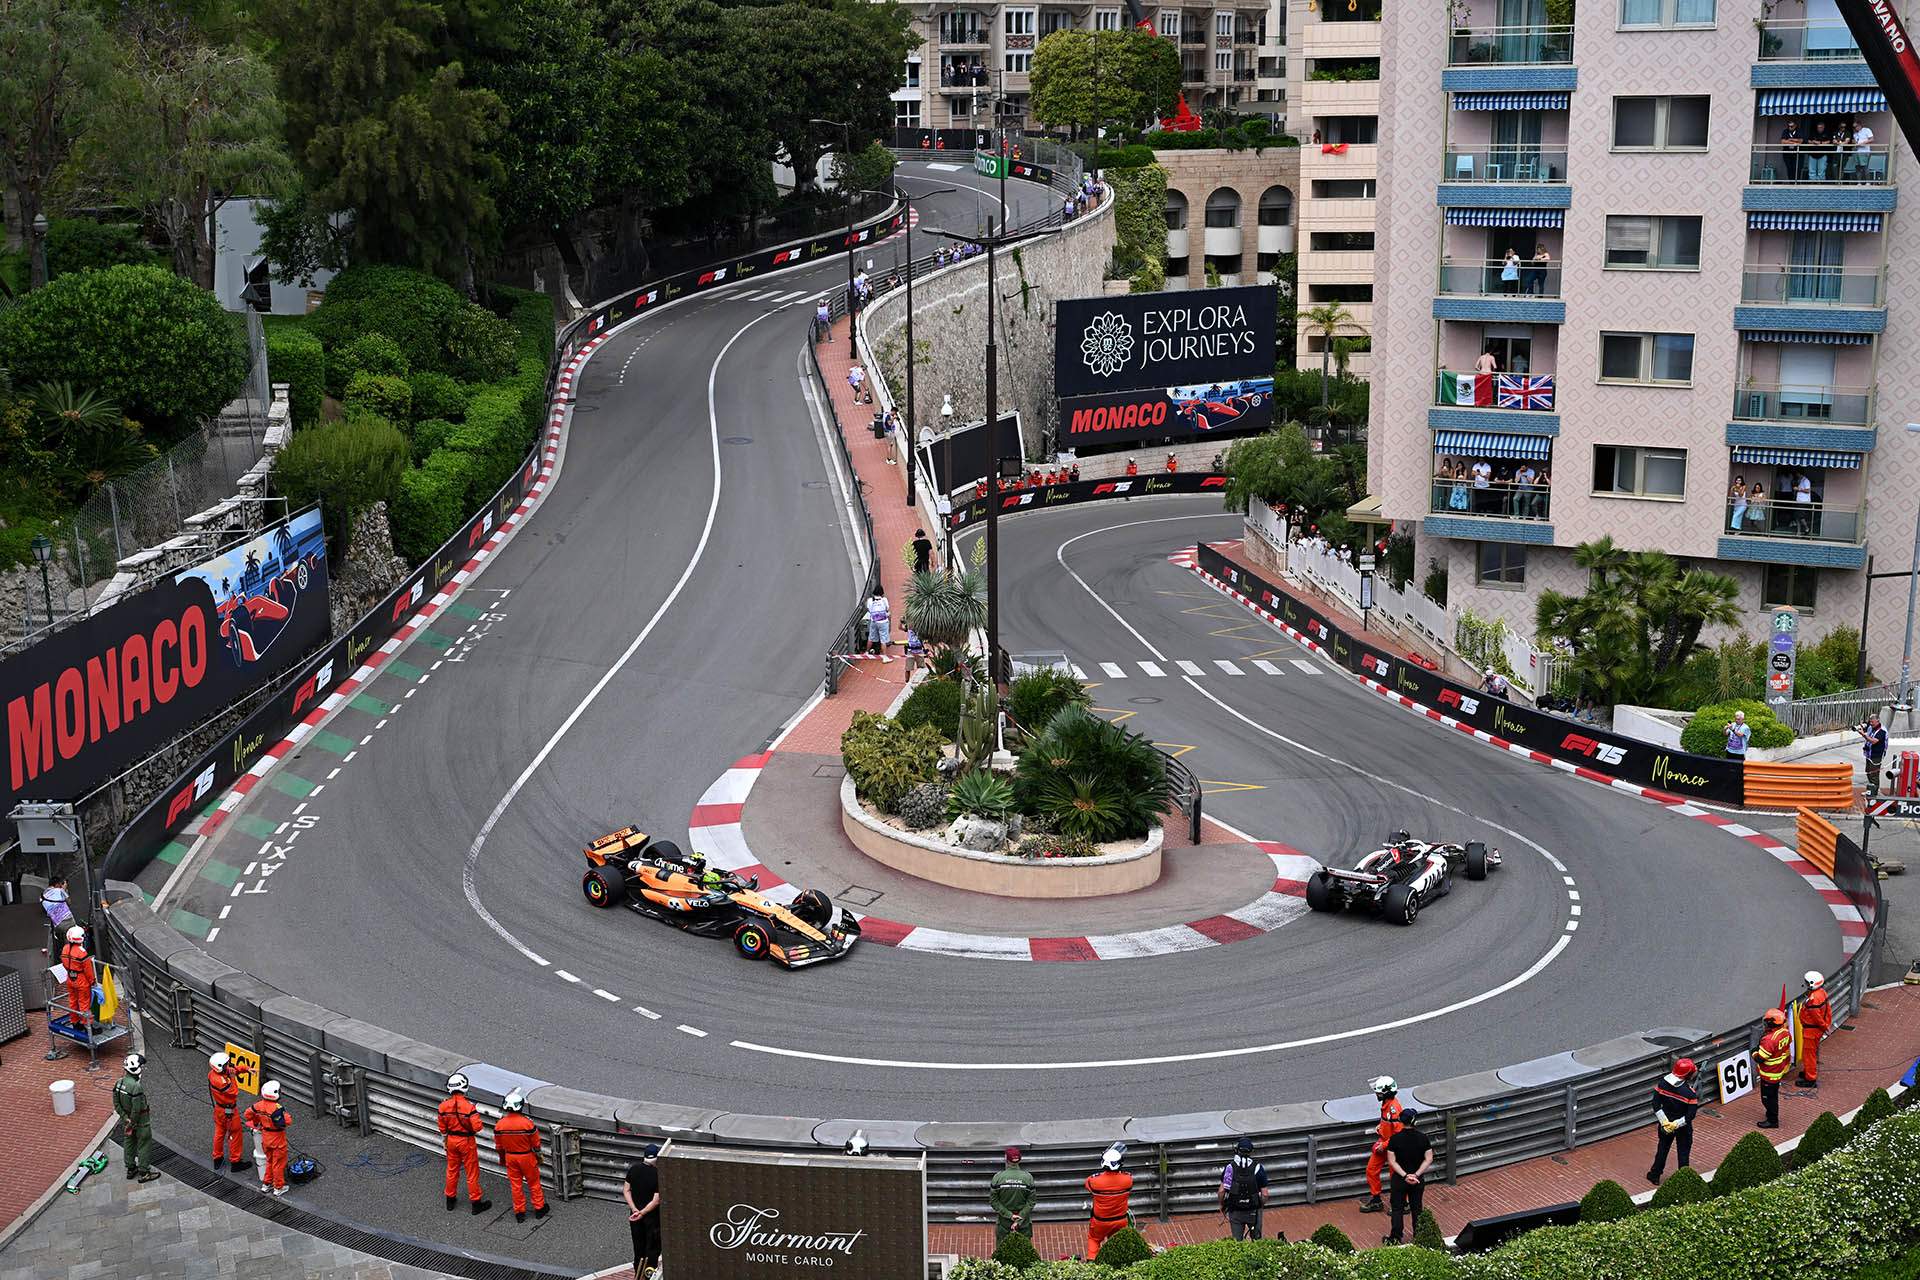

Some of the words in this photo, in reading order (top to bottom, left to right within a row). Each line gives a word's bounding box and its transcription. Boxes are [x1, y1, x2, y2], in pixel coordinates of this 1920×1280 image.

[1144, 305, 1247, 335] EXPLORA
[1140, 331, 1255, 370] JOURNEYS
[1070, 401, 1167, 434] MONACO
[7, 604, 208, 793] MONACO
[1494, 705, 1526, 736] Monaco
[234, 733, 265, 773] Monaco
[1652, 755, 1709, 789] Monaco
[243, 815, 321, 895] TAXIS
[654, 857, 685, 873] Chrome
[1724, 1058, 1749, 1095] SC
[709, 1203, 868, 1255] Fairmont
[746, 1252, 788, 1265] MONTE
[794, 1256, 834, 1267] CARLO
